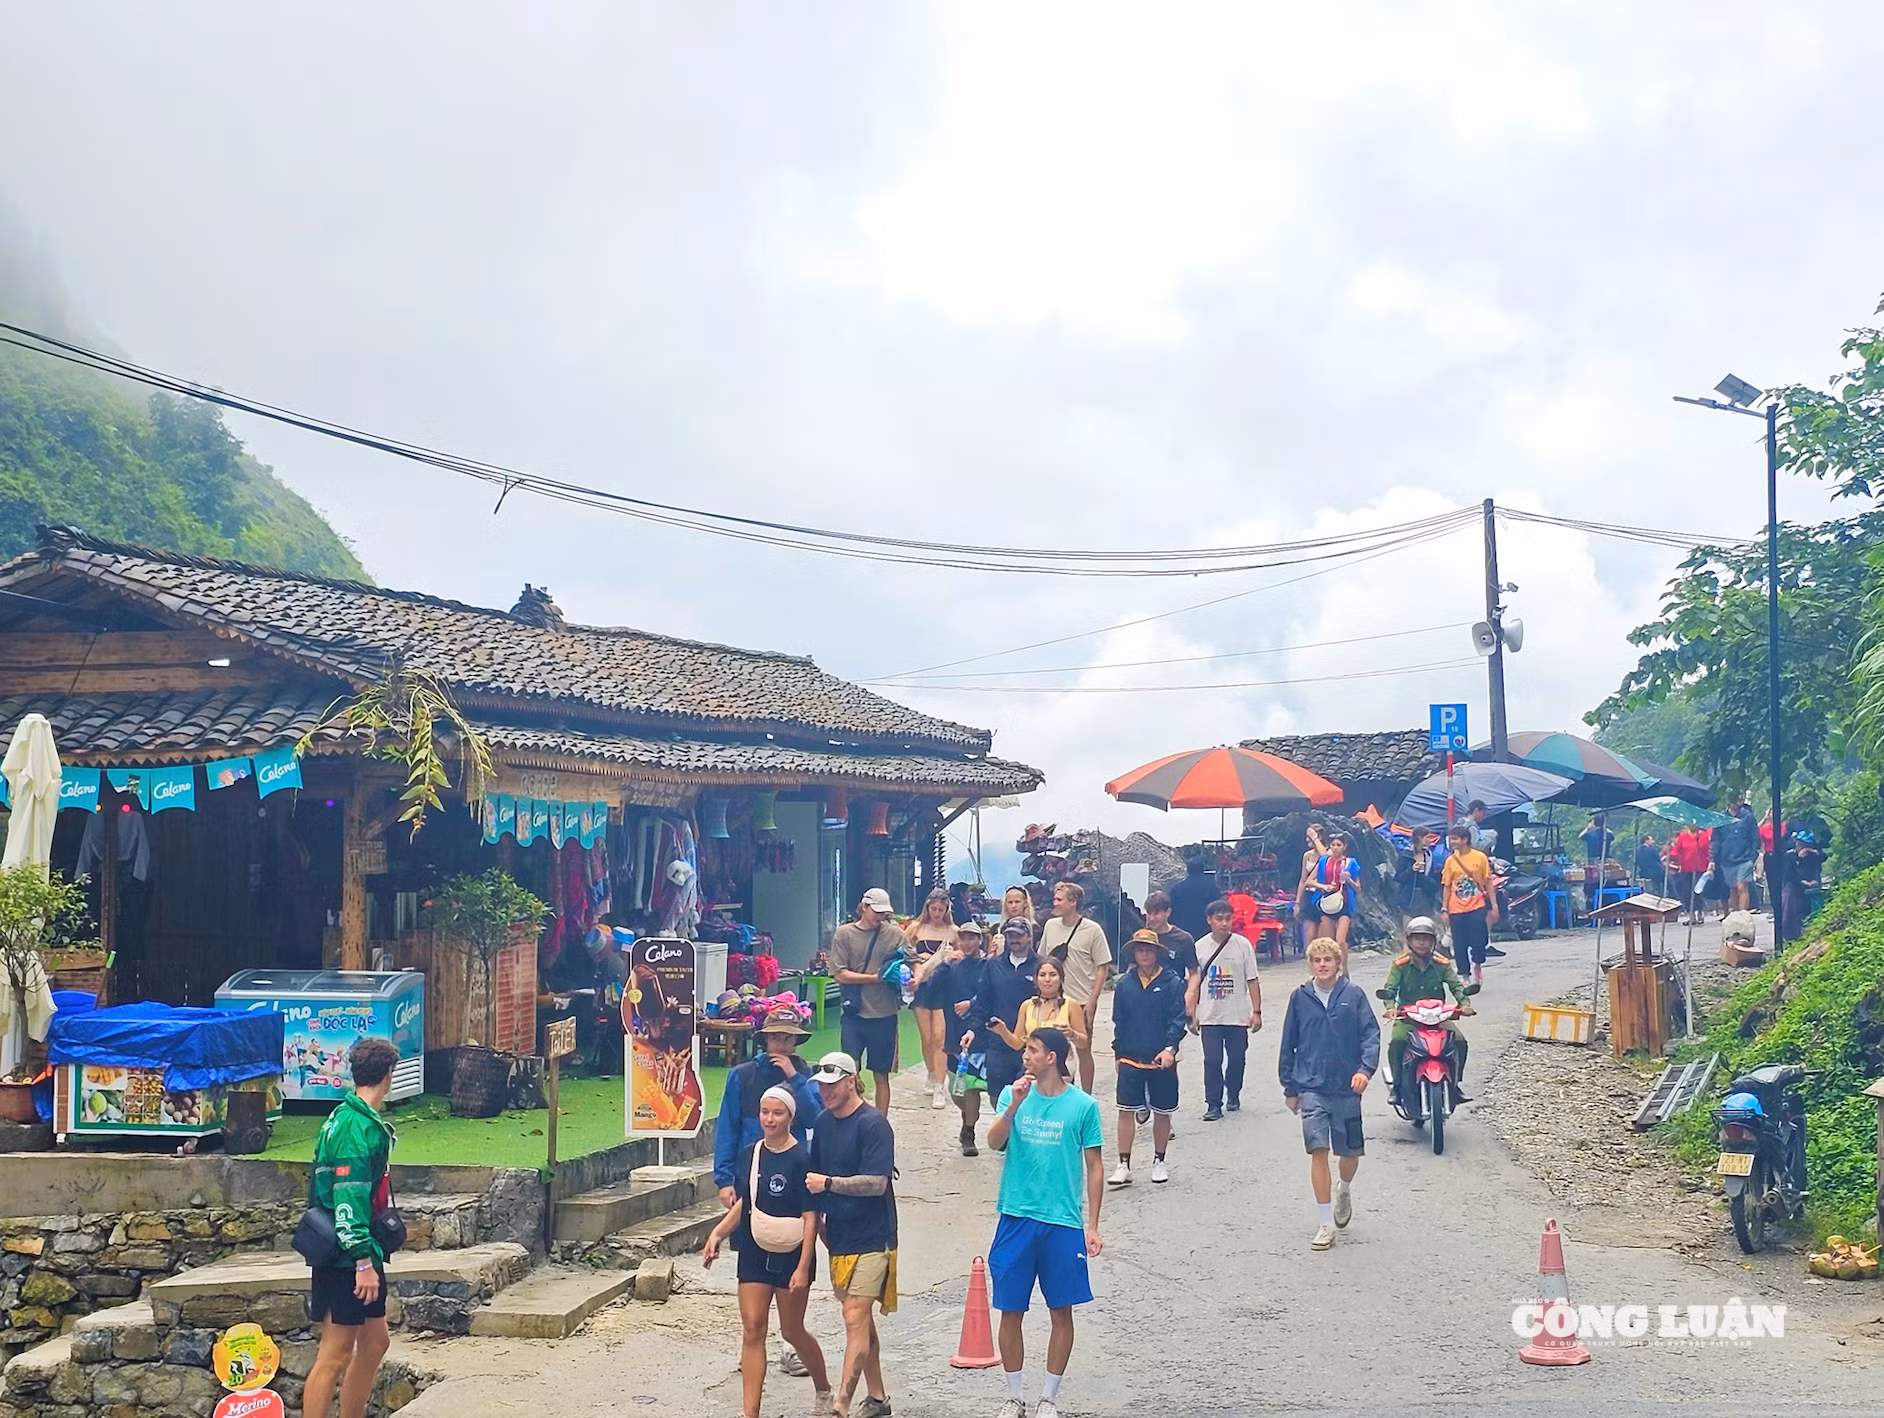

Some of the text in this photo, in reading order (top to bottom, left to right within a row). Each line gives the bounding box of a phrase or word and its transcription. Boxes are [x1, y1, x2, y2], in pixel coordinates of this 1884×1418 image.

[1440, 707, 1457, 733] P
[258, 761, 297, 783] Celano
[59, 781, 97, 798] Celano
[153, 781, 192, 800] Celano
[645, 944, 683, 962] Celano
[1022, 1116, 1035, 1125] Go
[227, 1398, 271, 1416] Merino
